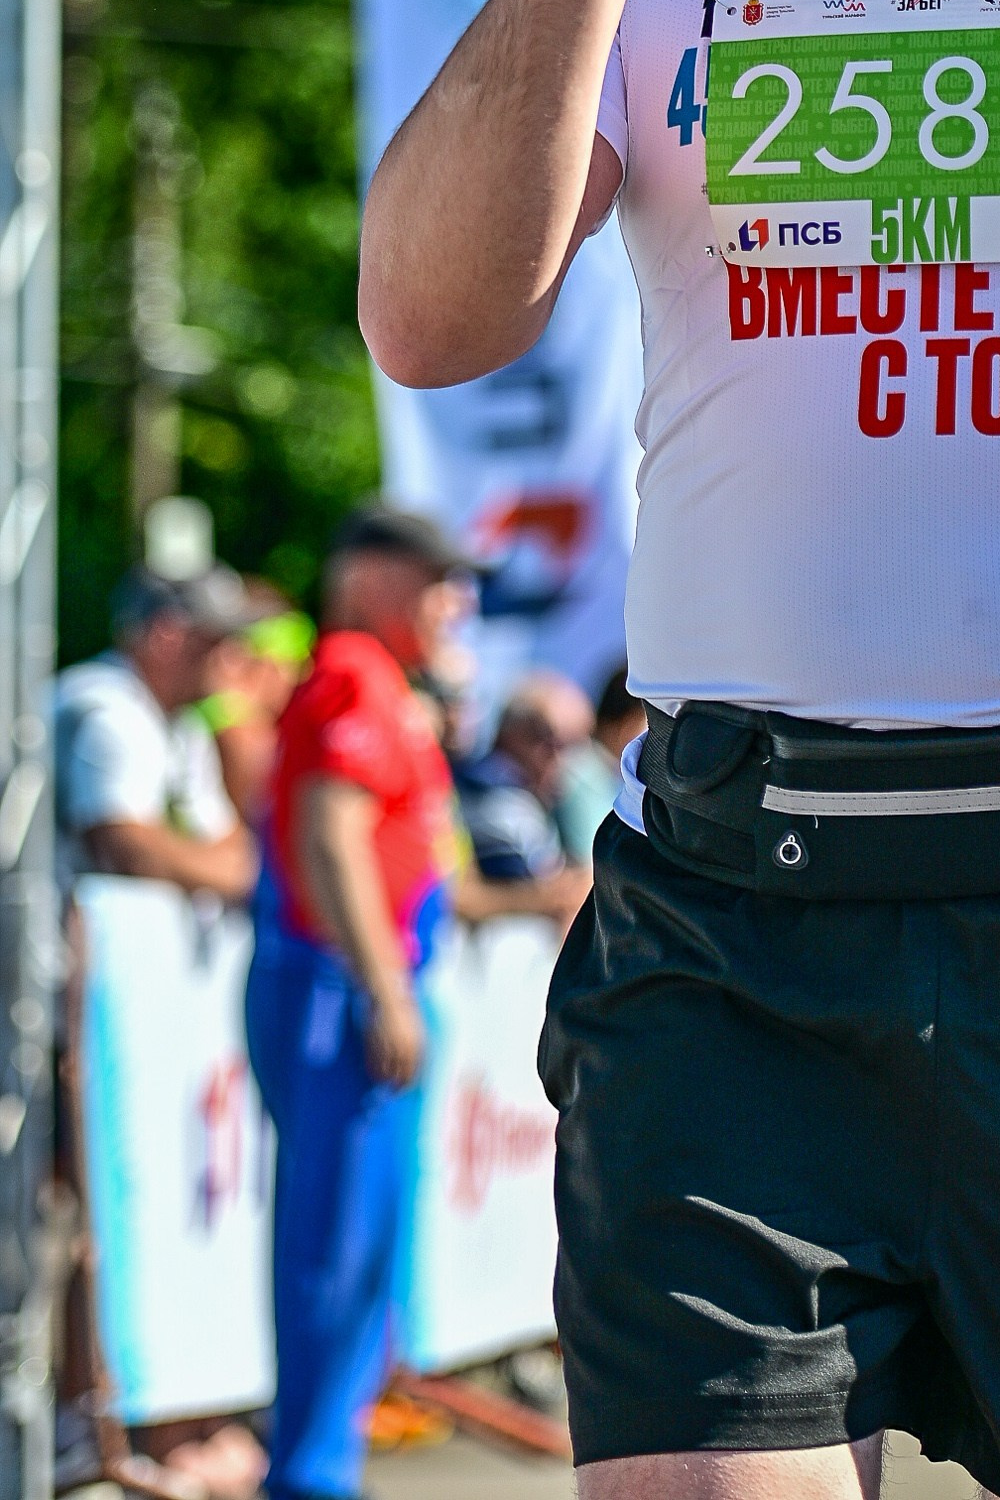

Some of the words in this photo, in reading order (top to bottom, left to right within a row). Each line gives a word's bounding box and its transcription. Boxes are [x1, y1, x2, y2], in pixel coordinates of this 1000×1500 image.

[778, 220, 843, 247] ПСБ
[727, 264, 995, 342] ВМЕСТЕ
[857, 340, 909, 438] С
